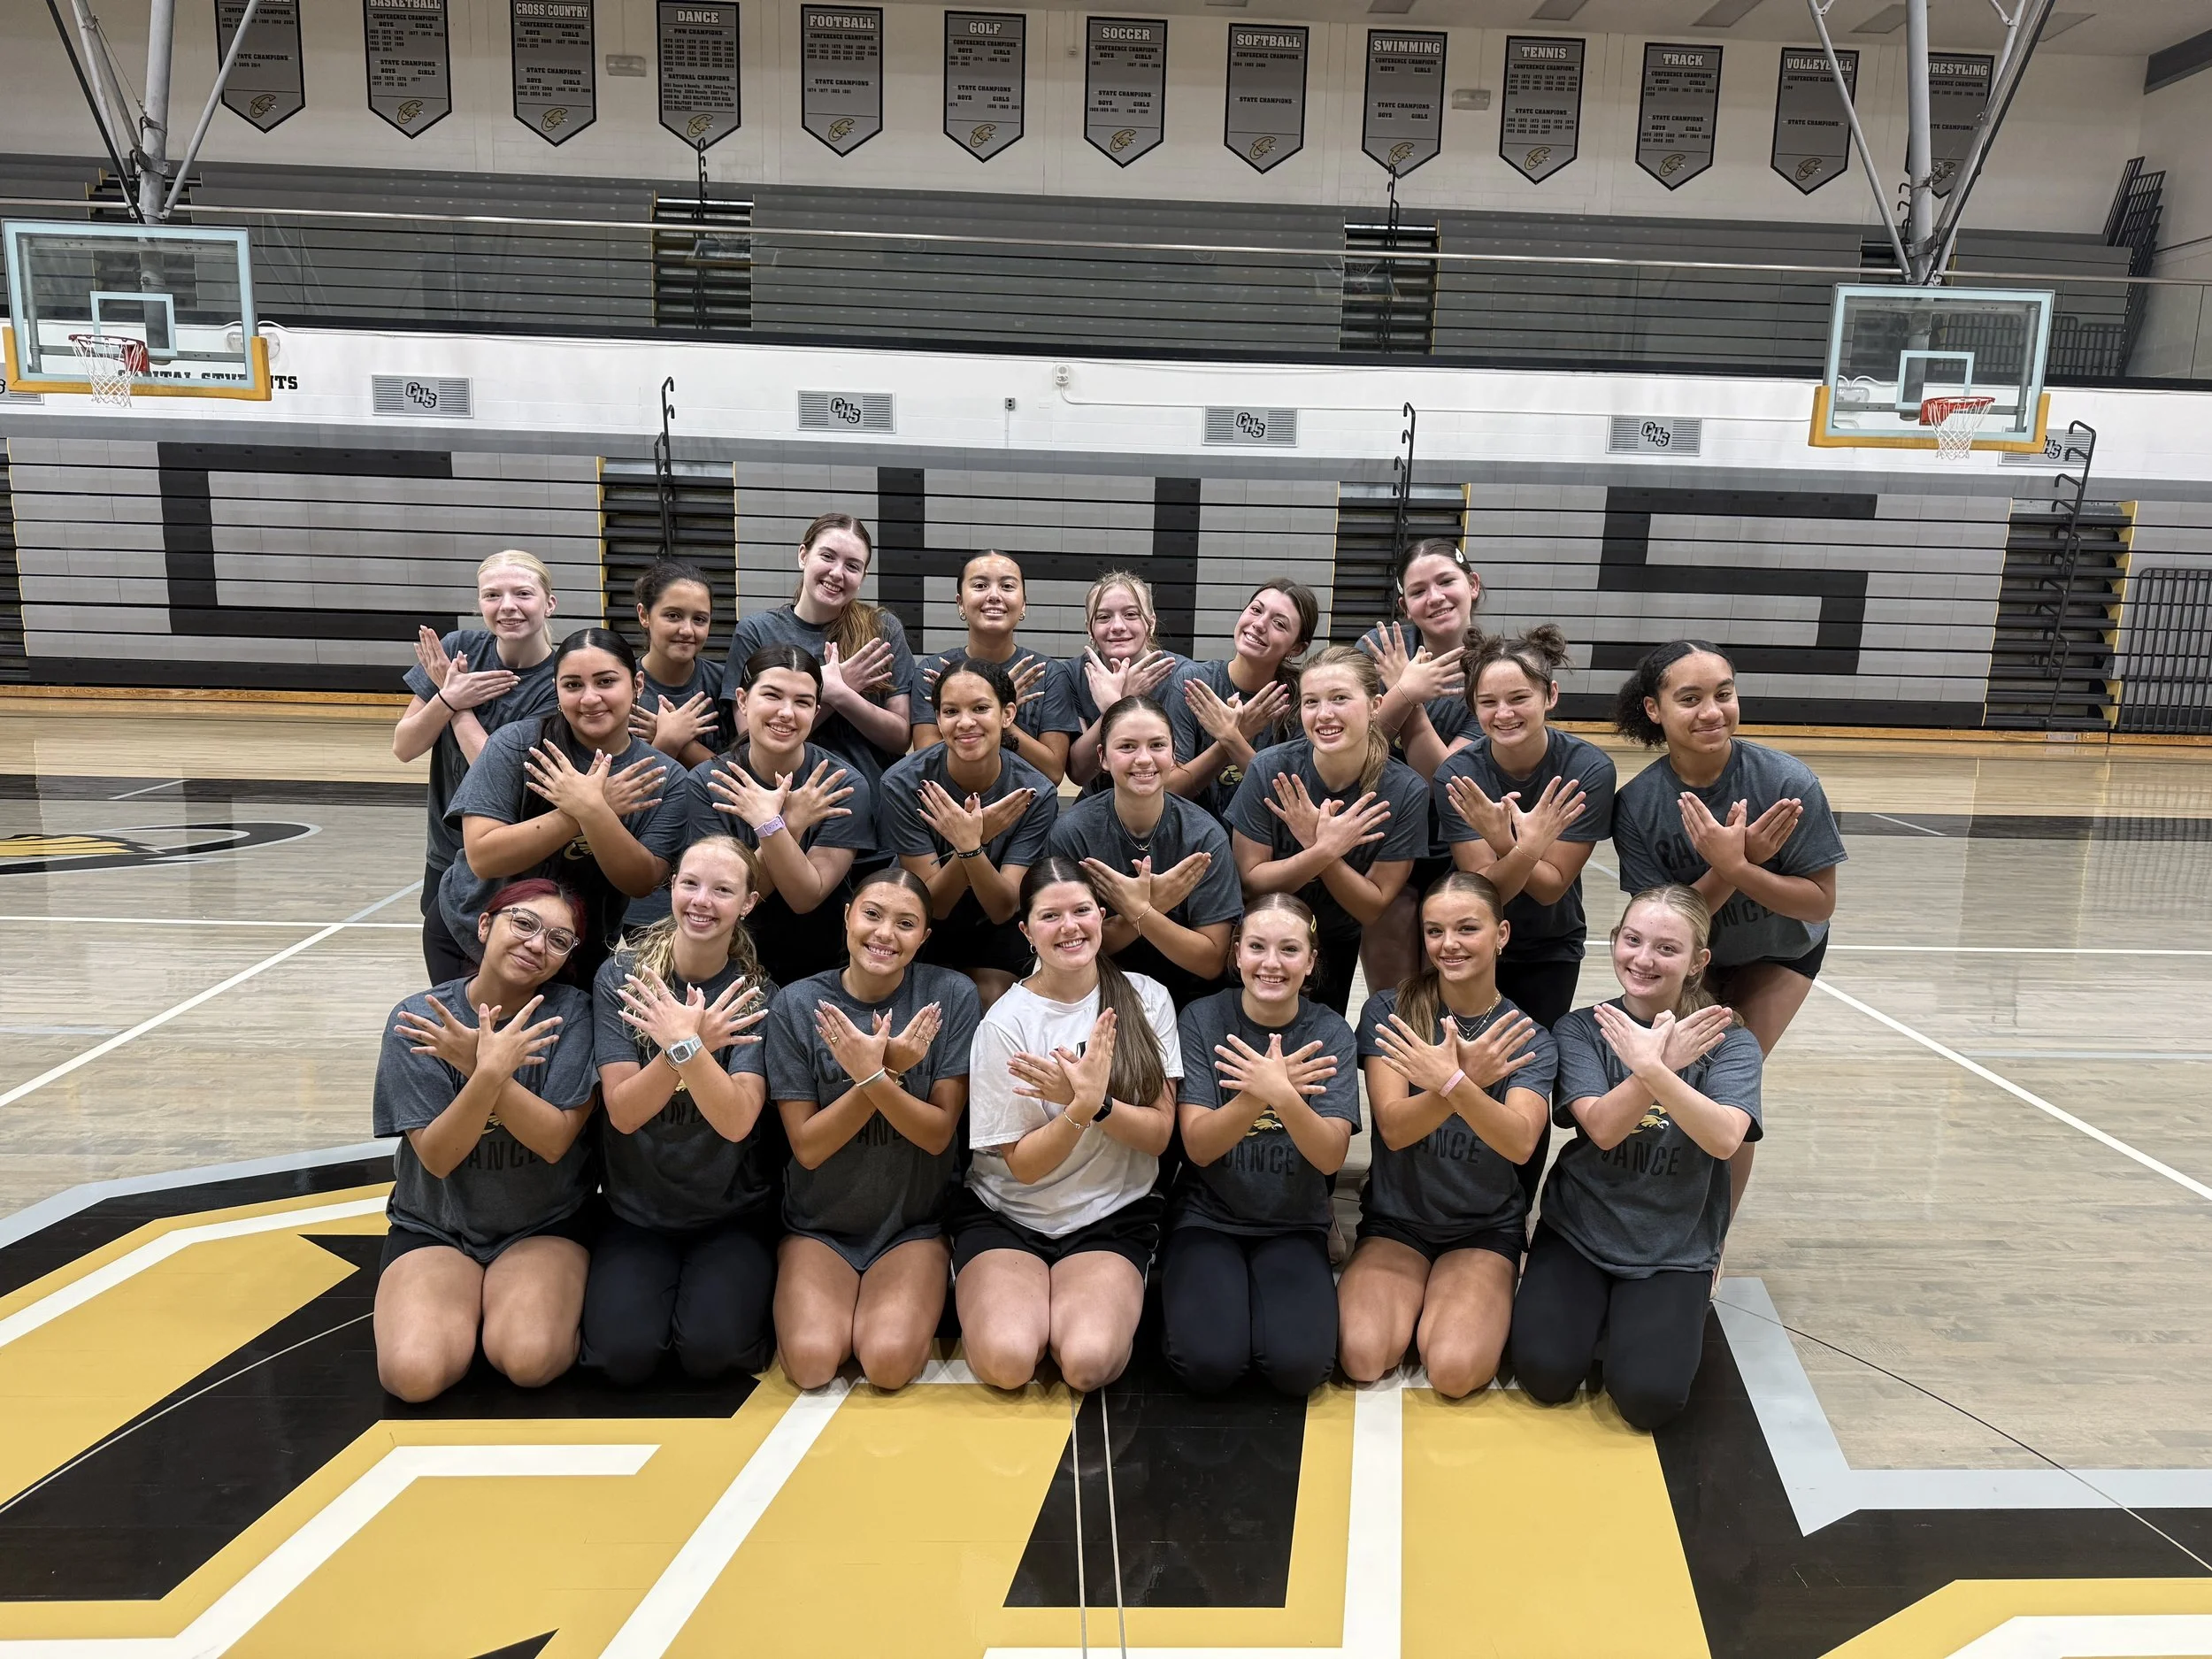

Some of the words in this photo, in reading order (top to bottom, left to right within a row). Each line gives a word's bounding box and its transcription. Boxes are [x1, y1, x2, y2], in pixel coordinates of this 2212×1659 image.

[369, 0, 441, 10] BASKETBALL
[516, 3, 545, 16] CROSS
[547, 4, 588, 18] COUNTRY
[676, 10, 719, 24] DANCE
[809, 14, 875, 29] FOOTBALL
[969, 21, 1002, 35] GOLF
[1102, 27, 1151, 41] SOCCER
[1236, 33, 1301, 48] SOFTBALL
[1373, 39, 1441, 54] SWIMMING
[1521, 46, 1567, 59] TENNIS
[1663, 53, 1703, 66] TRACK
[405, 381, 437, 408] CHS
[830, 397, 861, 424] CHS
[1236, 411, 1265, 438] CHS
[1641, 421, 1671, 447] CHS
[2044, 434, 2062, 459] HS
